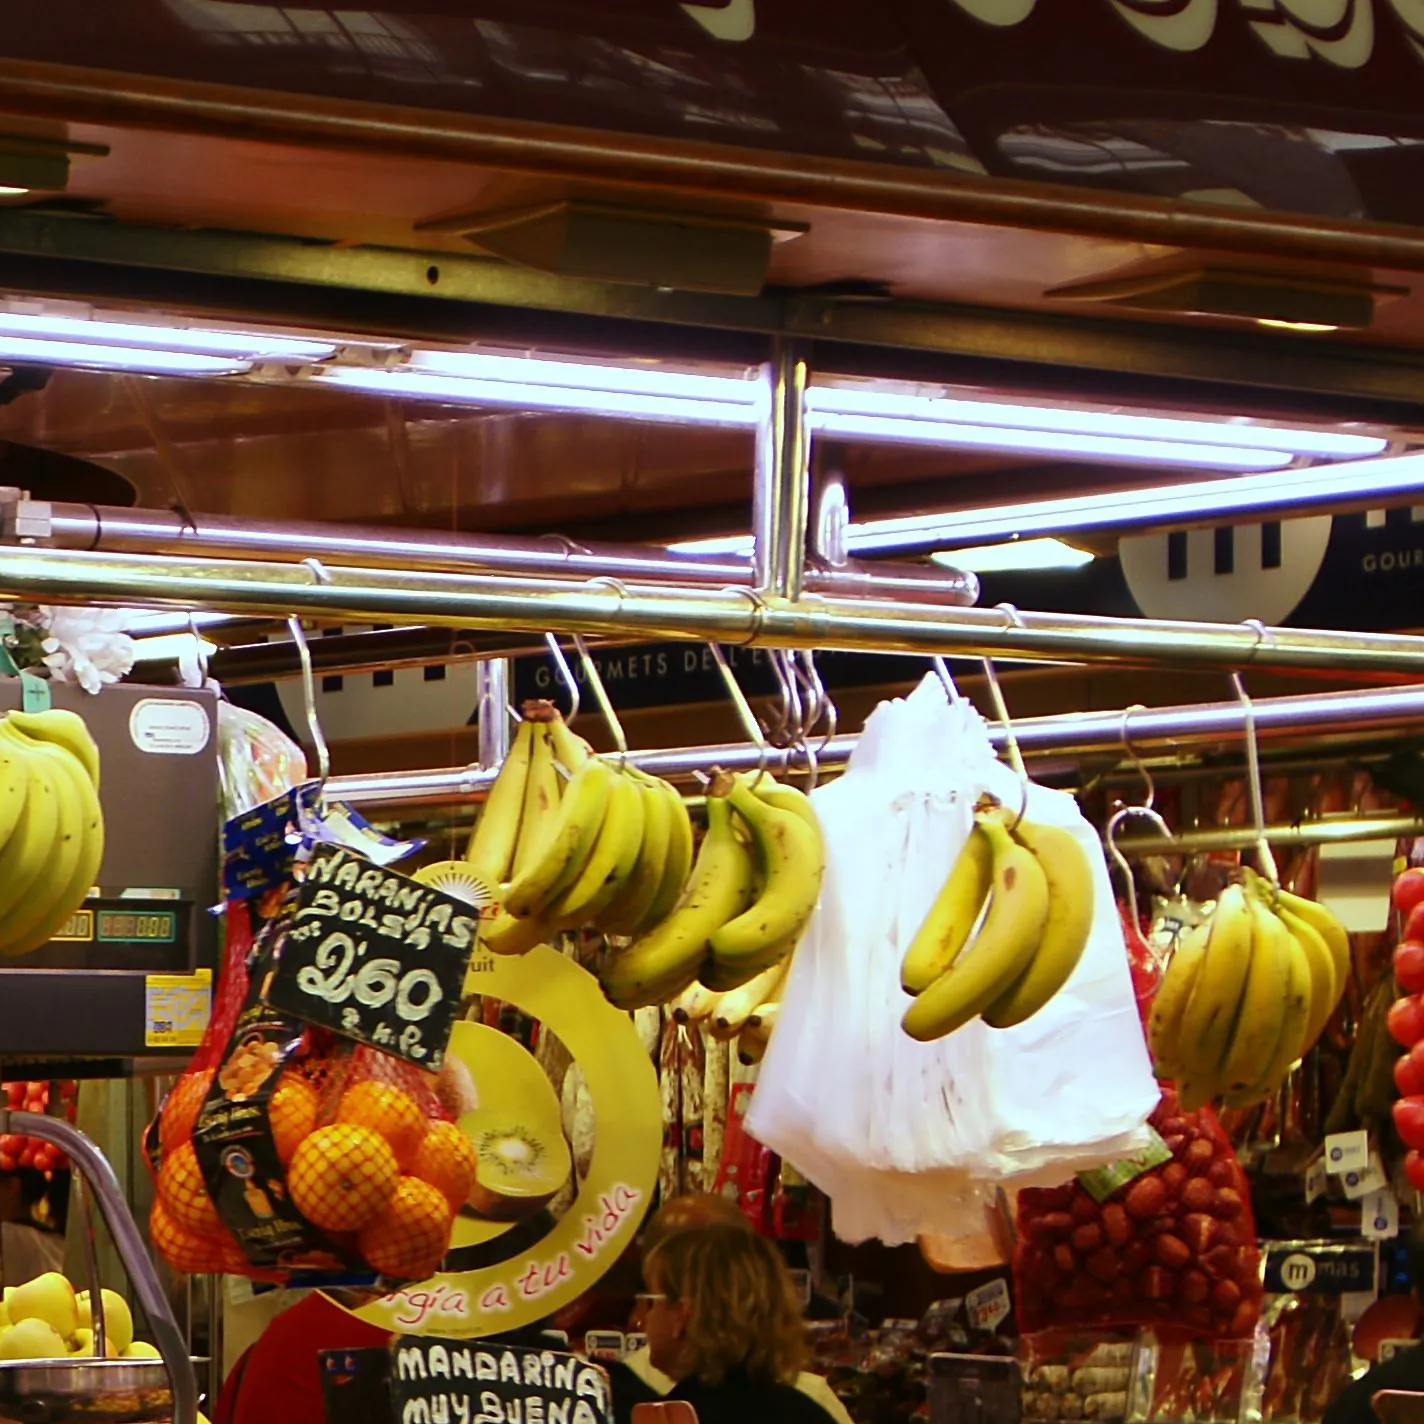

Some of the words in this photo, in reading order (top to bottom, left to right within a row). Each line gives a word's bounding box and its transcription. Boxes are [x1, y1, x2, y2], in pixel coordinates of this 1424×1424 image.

[296, 889, 431, 950] BOLSA
[518, 1255, 569, 1296] tu
[577, 1184, 637, 1255] vida
